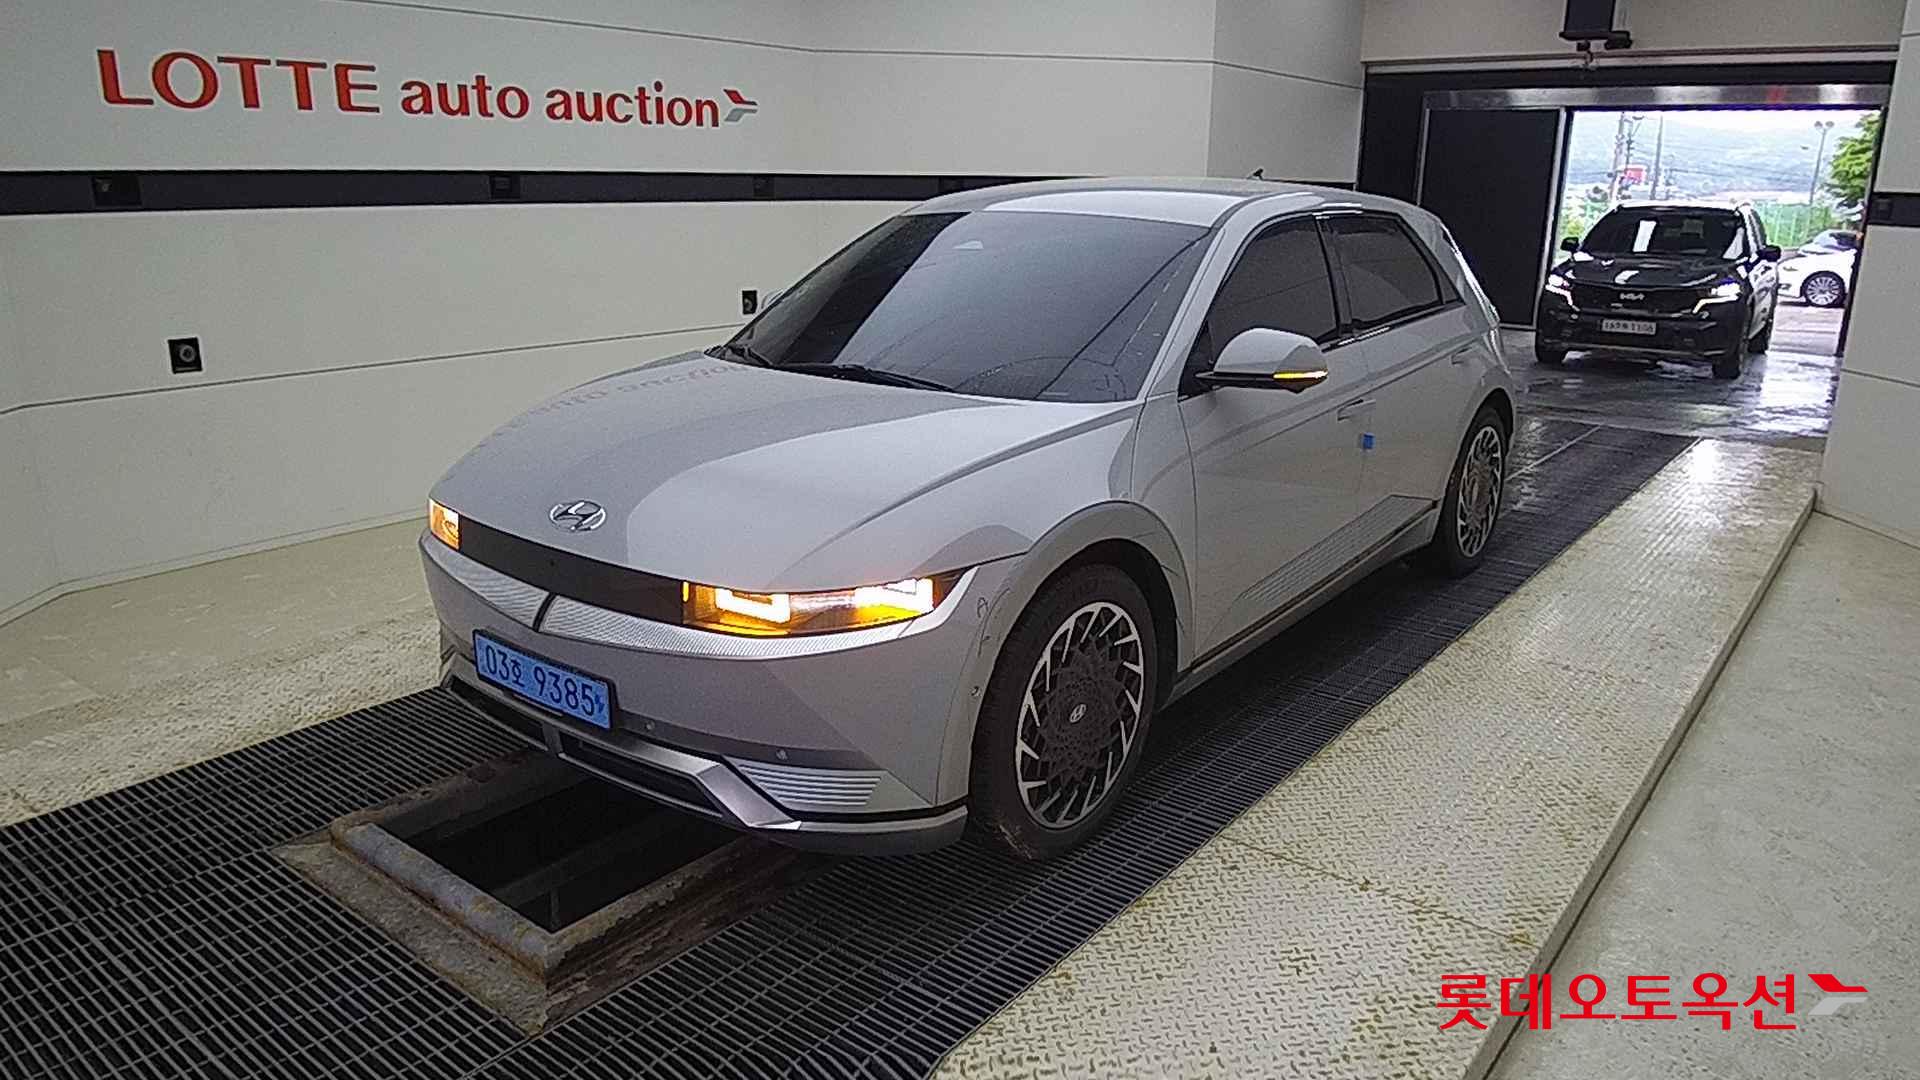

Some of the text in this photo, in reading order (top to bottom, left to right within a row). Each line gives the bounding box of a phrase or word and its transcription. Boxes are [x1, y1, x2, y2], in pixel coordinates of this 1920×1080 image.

[98, 49, 721, 128] LOTTE auto auction
[485, 644, 596, 717] 03호 9385
